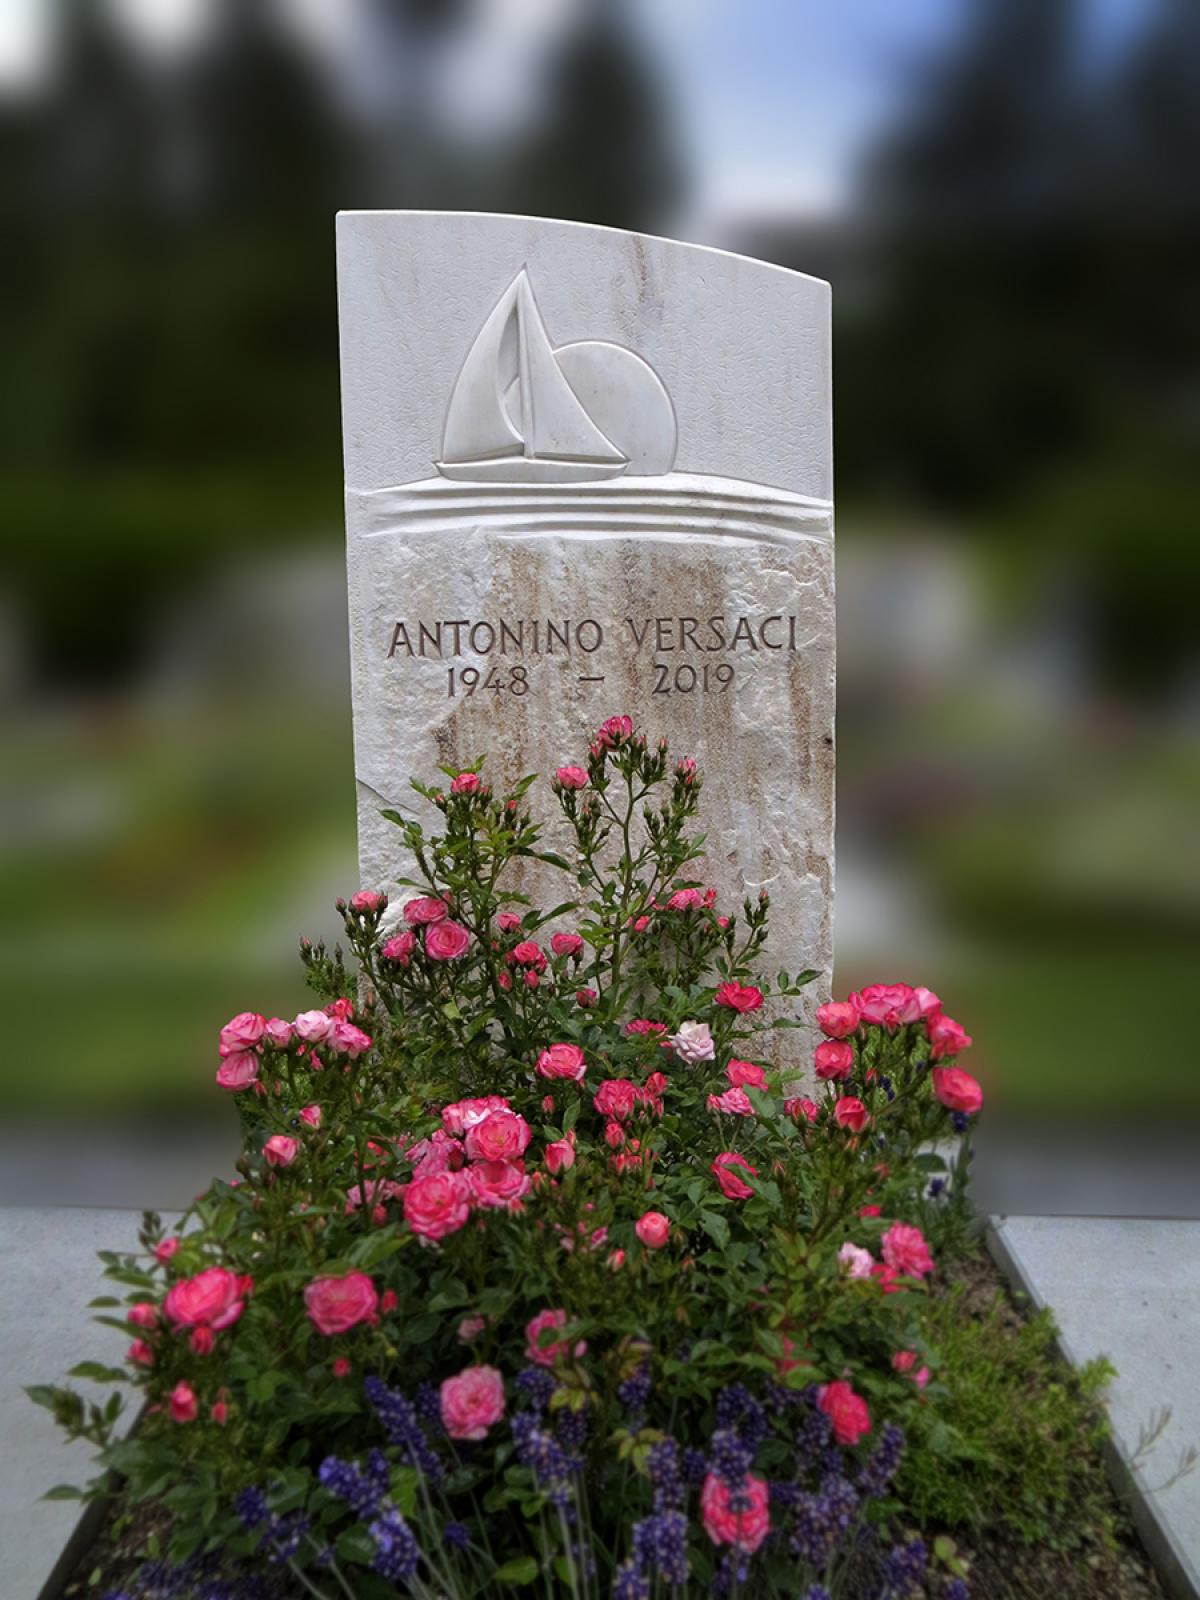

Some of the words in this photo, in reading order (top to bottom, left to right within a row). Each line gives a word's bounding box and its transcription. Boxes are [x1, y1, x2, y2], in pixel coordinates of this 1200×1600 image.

[388, 618, 603, 658] ANTONINO
[623, 616, 797, 653] VERSACI
[447, 665, 530, 698] 1948
[652, 663, 735, 696] 2019
